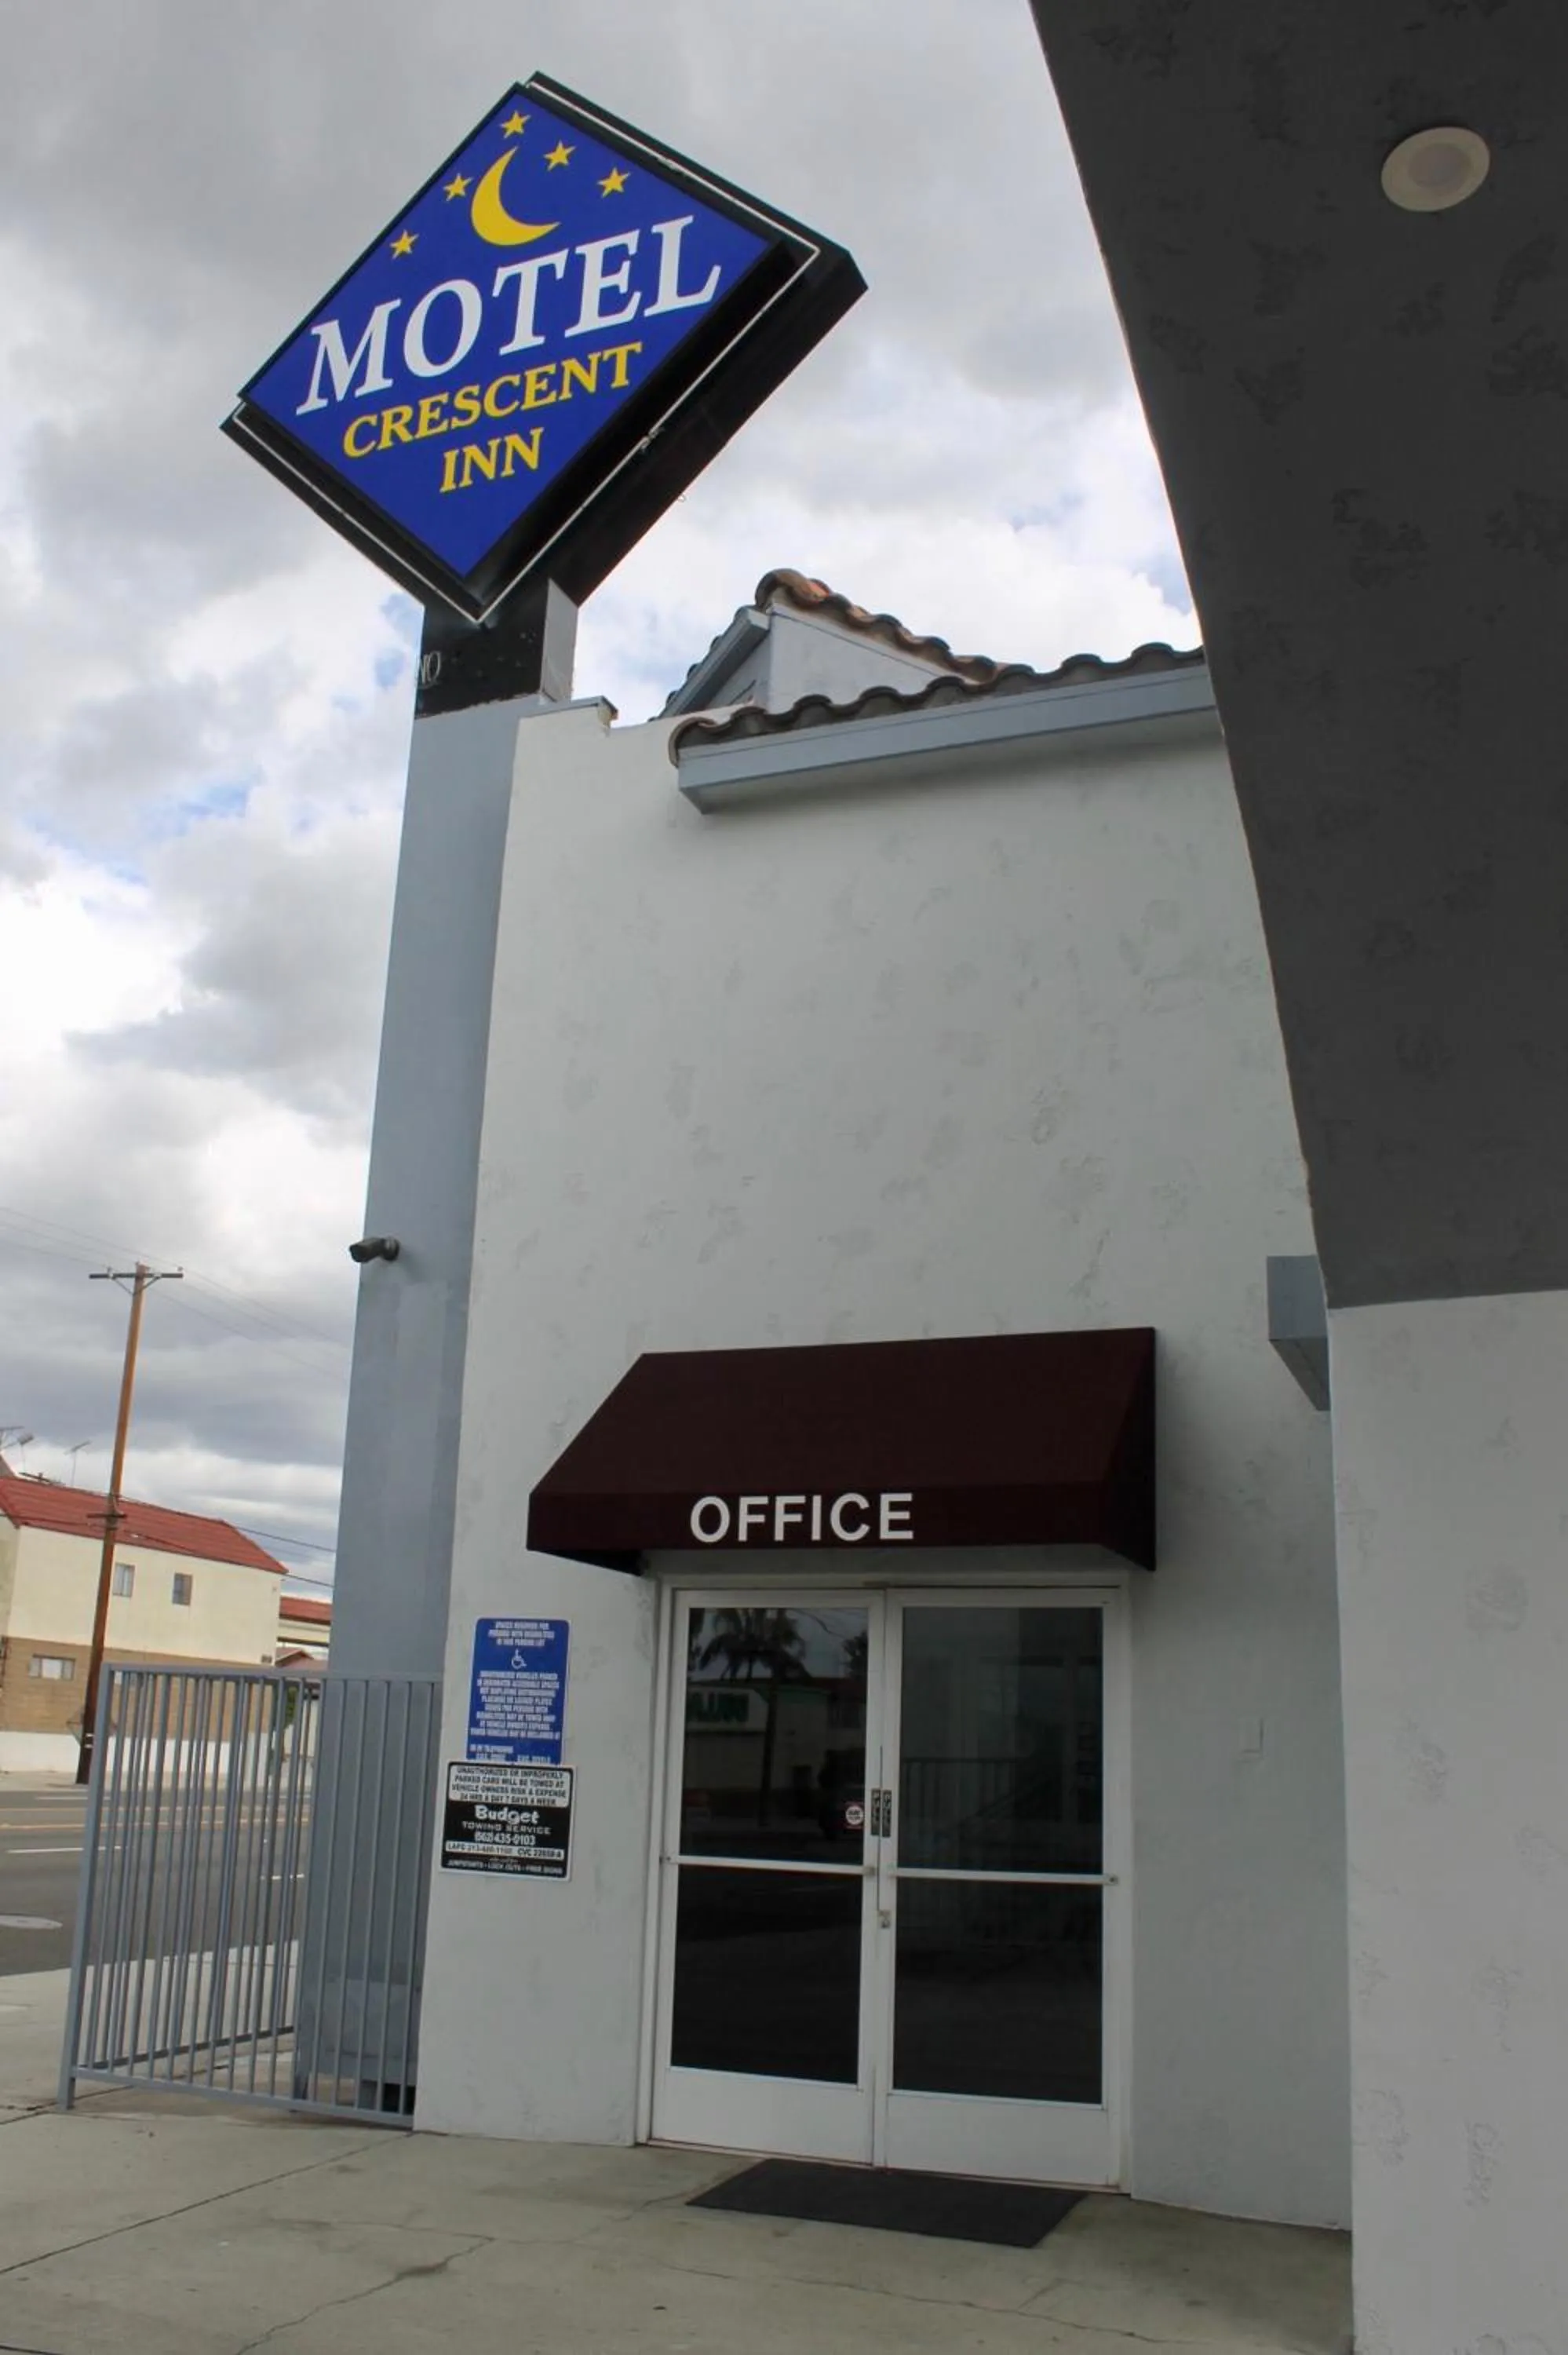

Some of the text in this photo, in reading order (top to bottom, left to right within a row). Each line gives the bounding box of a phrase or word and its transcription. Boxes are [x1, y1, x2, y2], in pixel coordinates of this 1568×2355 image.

[296, 214, 722, 416] MOTEL
[342, 341, 644, 458] CRESCENT
[439, 428, 544, 494] INN
[690, 1492, 914, 1543] OFFICE
[461, 1820, 552, 1835] TOWING SERVICE
[474, 1805, 540, 1824] Budget
